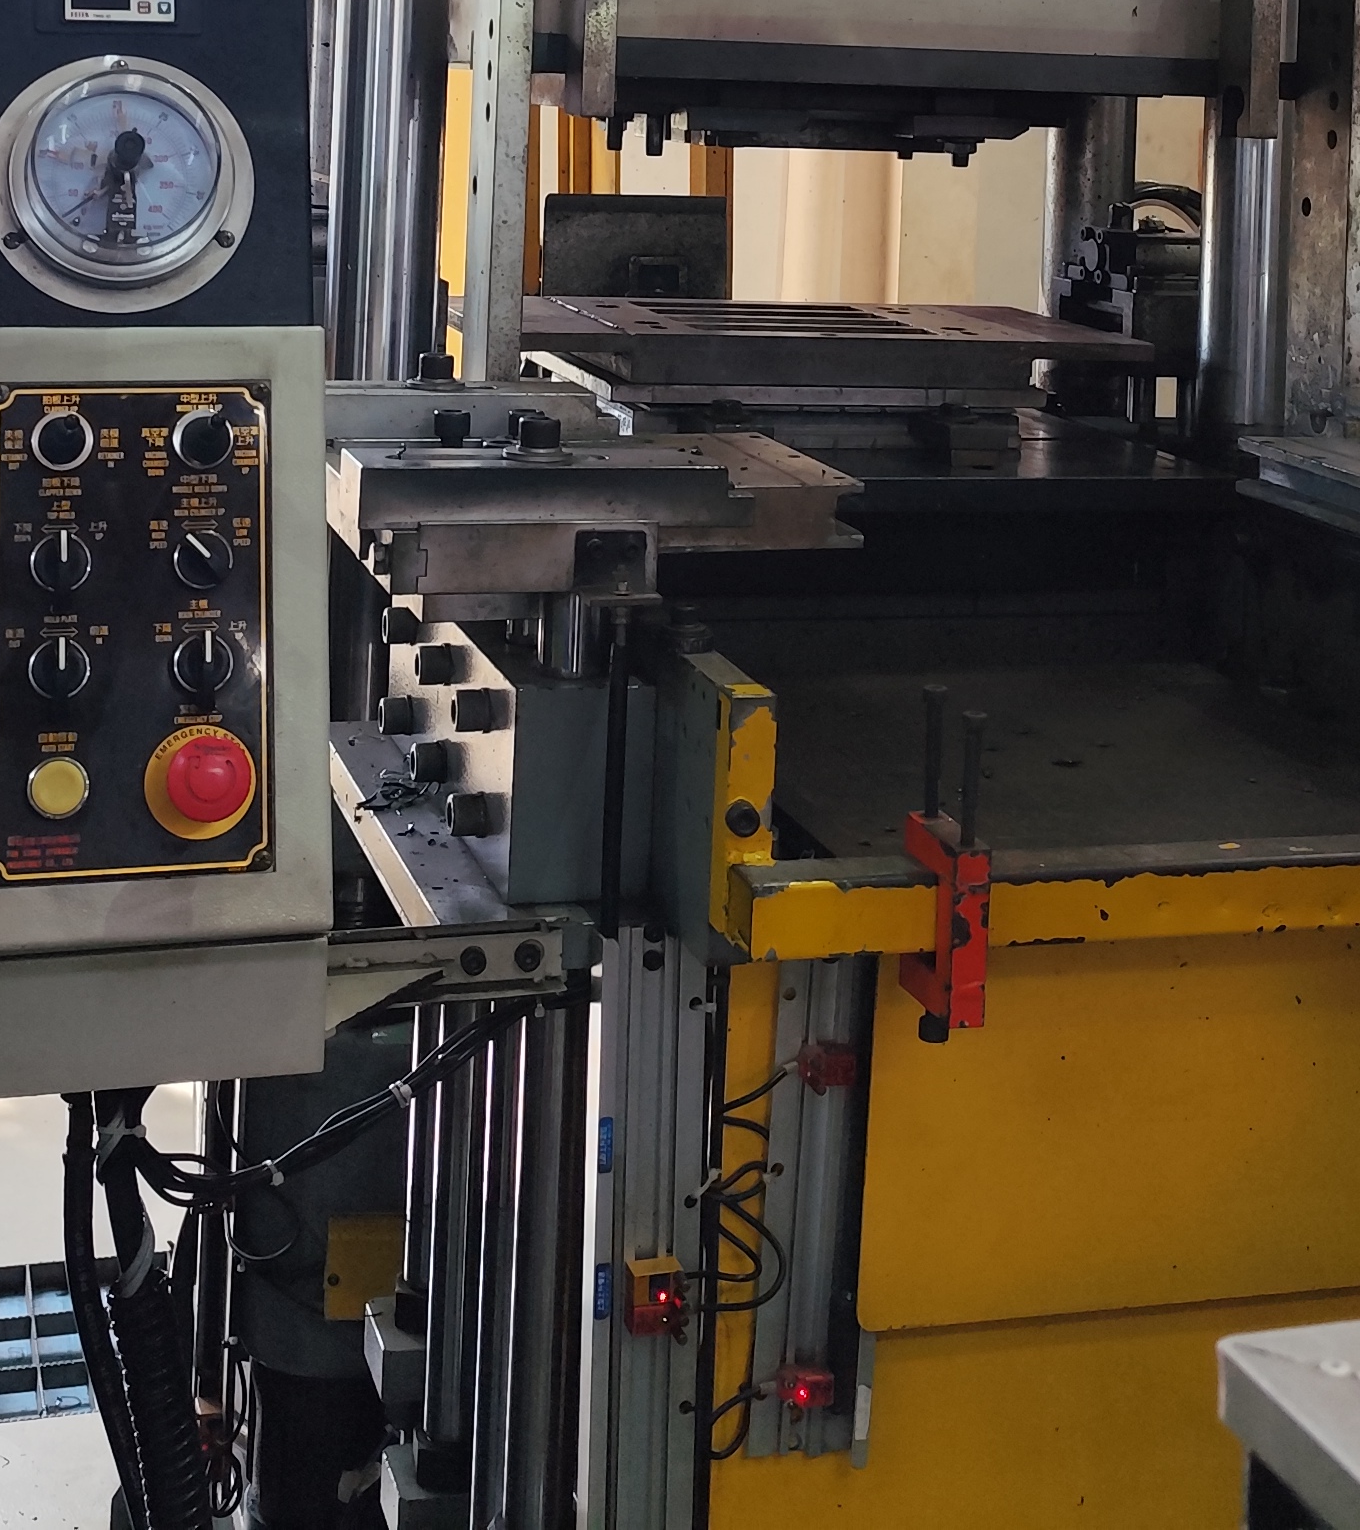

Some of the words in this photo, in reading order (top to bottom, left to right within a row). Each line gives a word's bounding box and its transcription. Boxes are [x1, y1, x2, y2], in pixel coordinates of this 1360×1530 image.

[89, 521, 107, 531] 上升
[228, 620, 247, 631] 上升
[154, 727, 219, 760] EMERGENCY
